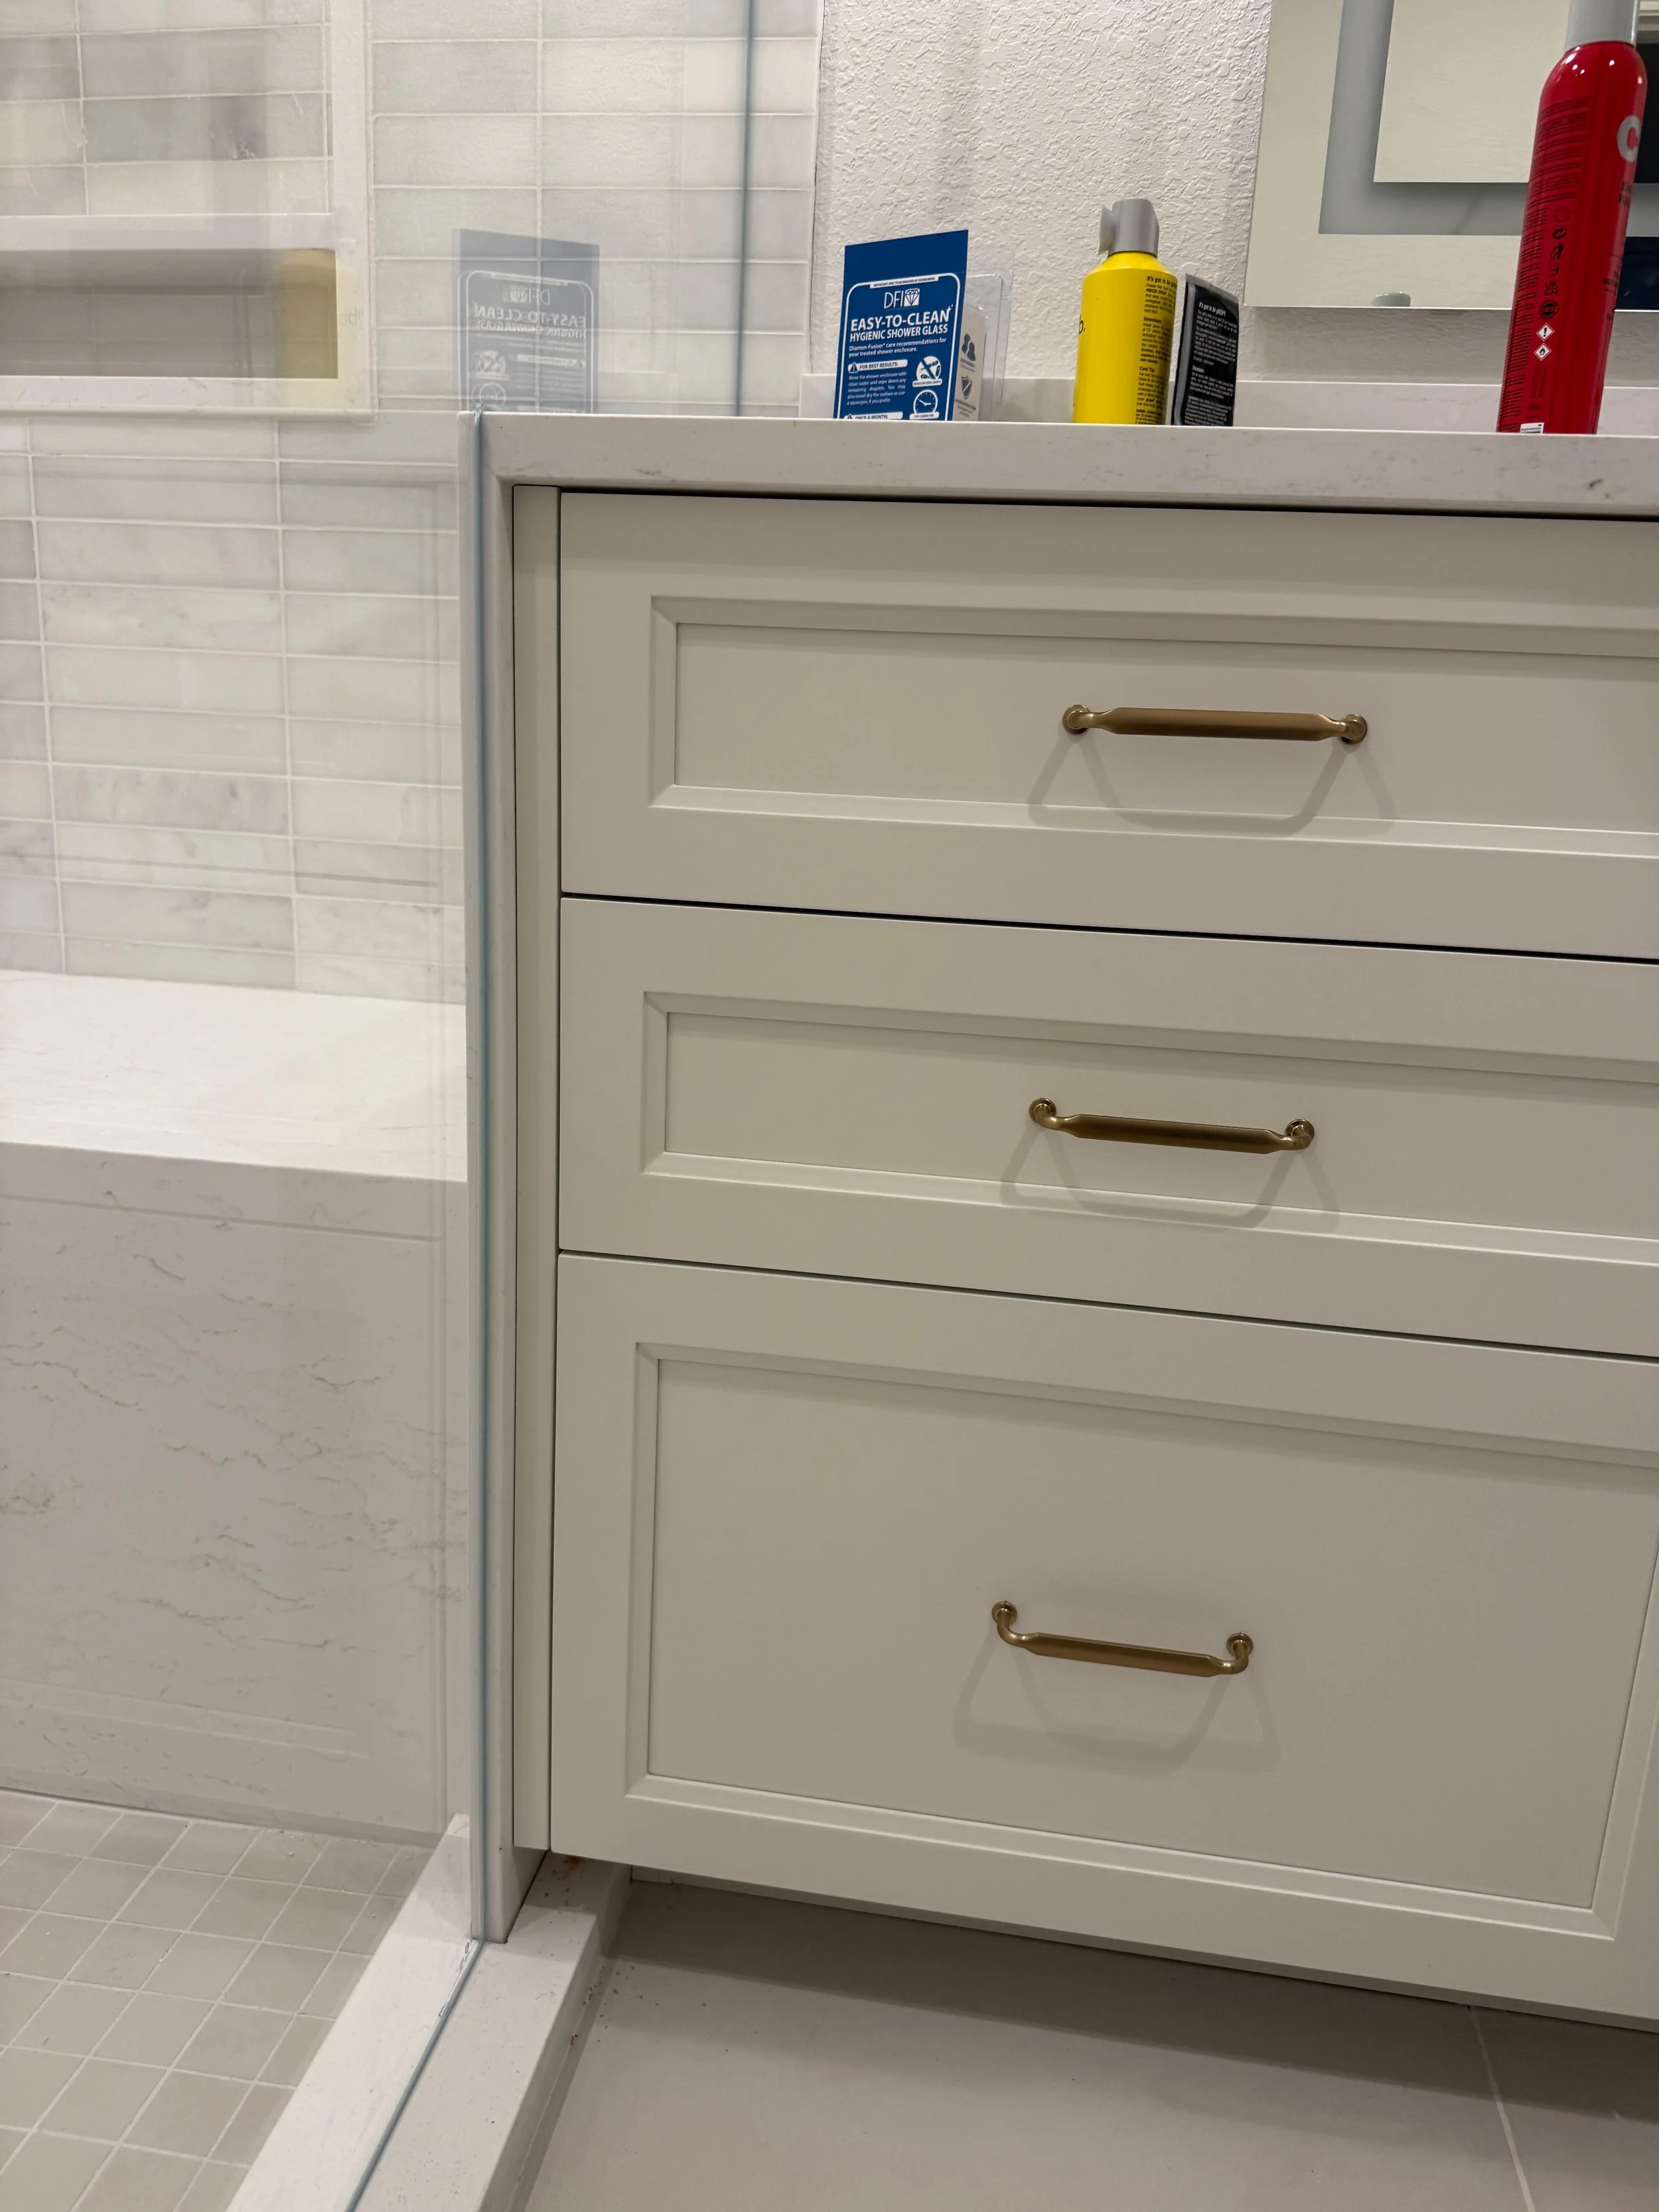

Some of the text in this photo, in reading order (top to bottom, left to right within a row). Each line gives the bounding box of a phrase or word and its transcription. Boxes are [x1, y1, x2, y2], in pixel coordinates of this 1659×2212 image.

[883, 290, 904, 309] DFI
[851, 309, 950, 332] EASY-TO-CLEAN
[850, 323, 948, 342] HYGIENIC SHOWER GLASS
[897, 338, 939, 347] recommendations
